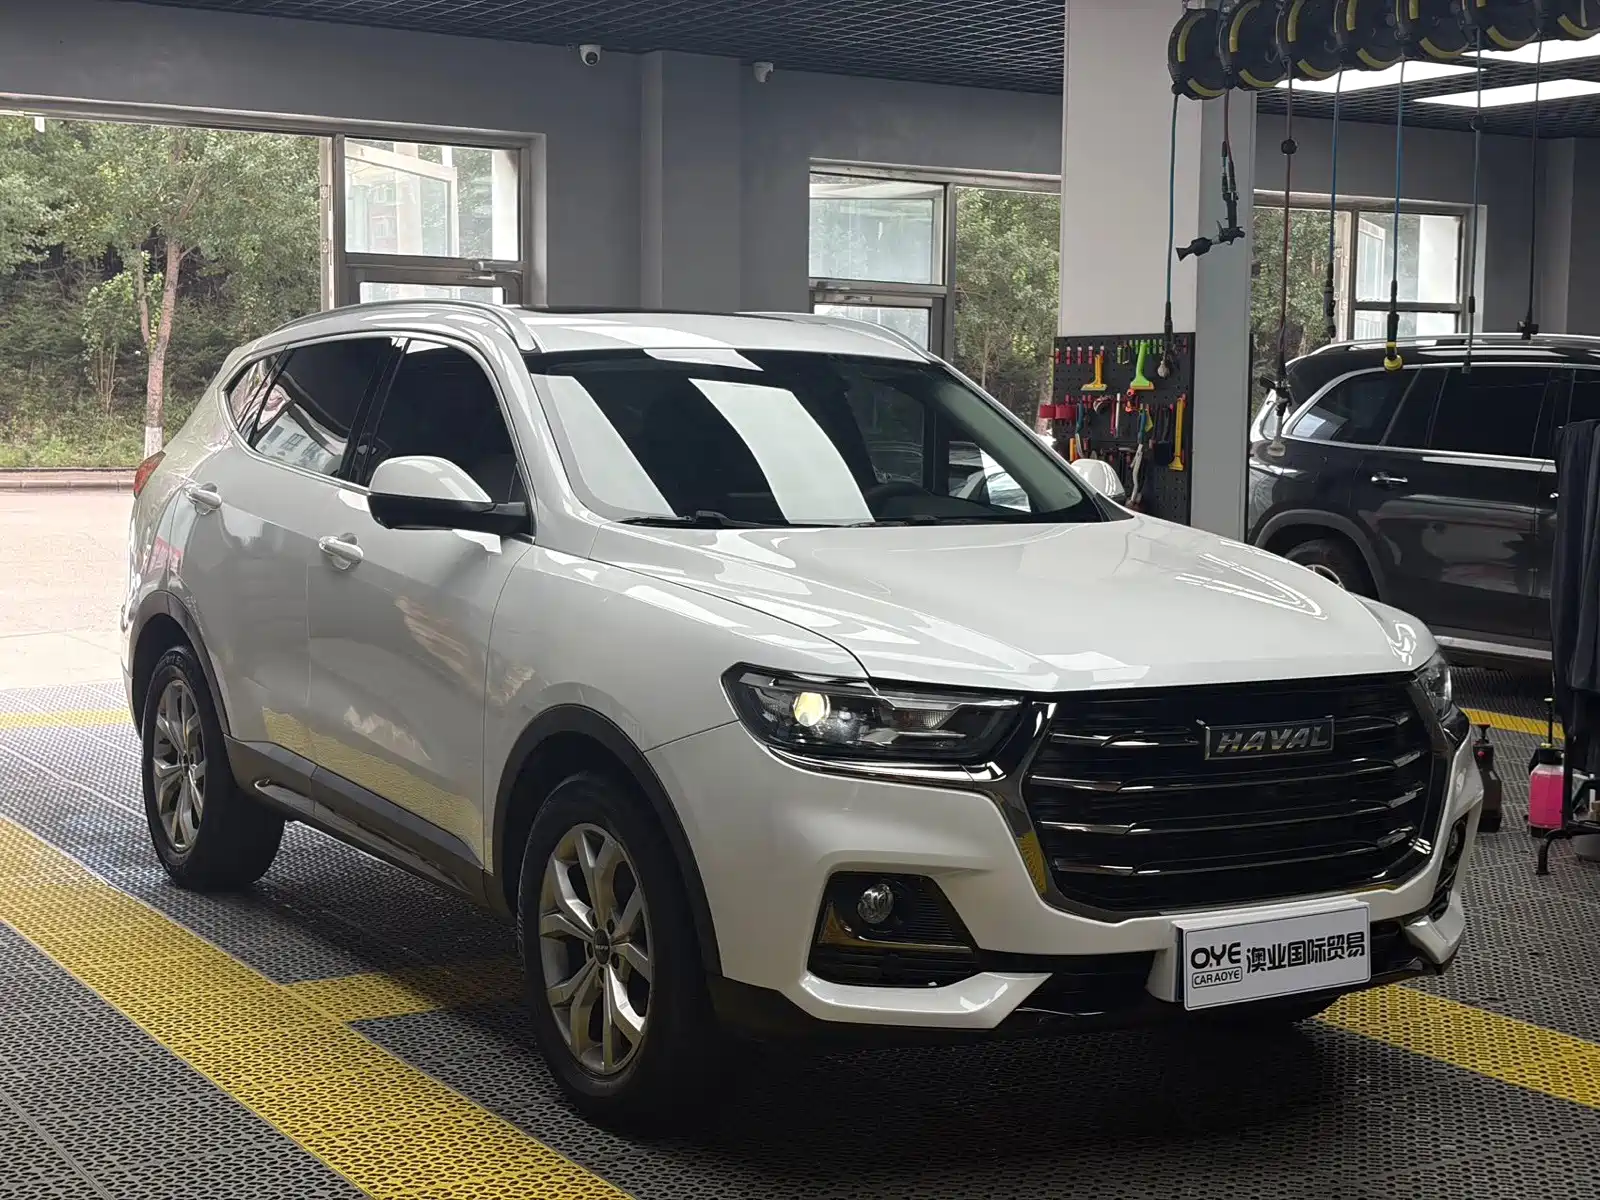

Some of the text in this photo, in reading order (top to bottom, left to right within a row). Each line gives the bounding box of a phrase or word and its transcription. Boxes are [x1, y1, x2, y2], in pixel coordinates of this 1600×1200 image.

[1216, 726, 1328, 753] HAVAL
[1246, 931, 1365, 974] 澳业国际贸易
[1194, 969, 1240, 986] CARAOYE
